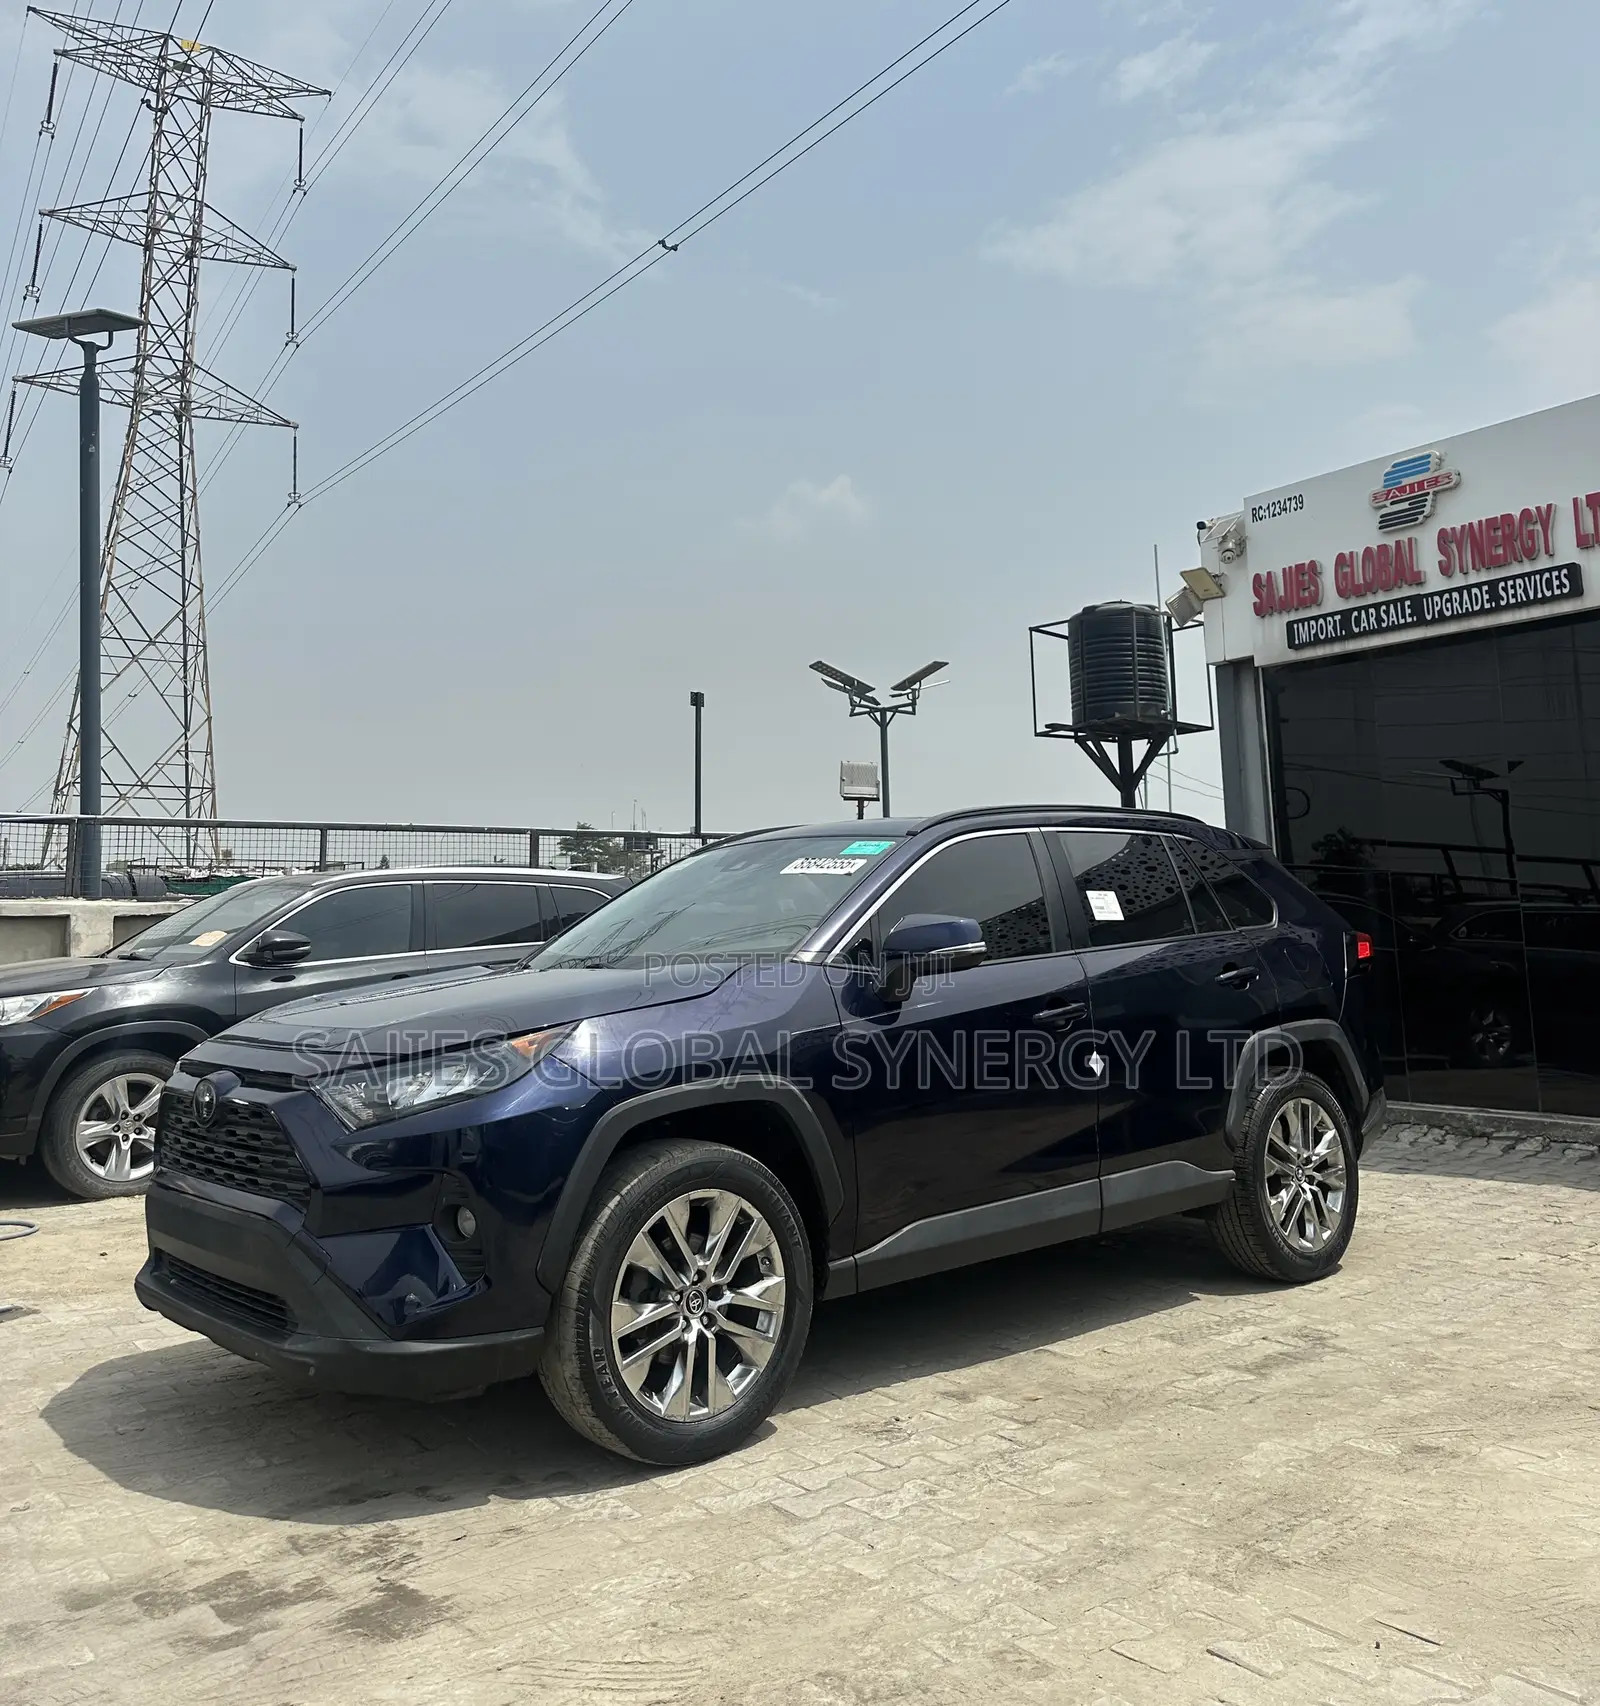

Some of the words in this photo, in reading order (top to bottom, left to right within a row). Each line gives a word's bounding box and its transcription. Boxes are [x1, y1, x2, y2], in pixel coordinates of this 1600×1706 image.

[1251, 494, 1304, 523] RC:1234739
[1372, 472, 1454, 504] SAJIES
[1252, 560, 1322, 617] SAJIES
[1334, 537, 1425, 599] GLOBAL
[1437, 503, 1556, 577] SYNERGY
[1294, 614, 1346, 645] IMPORT.
[1351, 607, 1378, 633] CAR
[1380, 599, 1417, 628] SALE.
[1423, 584, 1496, 621] UPGRADE.
[1498, 568, 1570, 606] SERVICES
